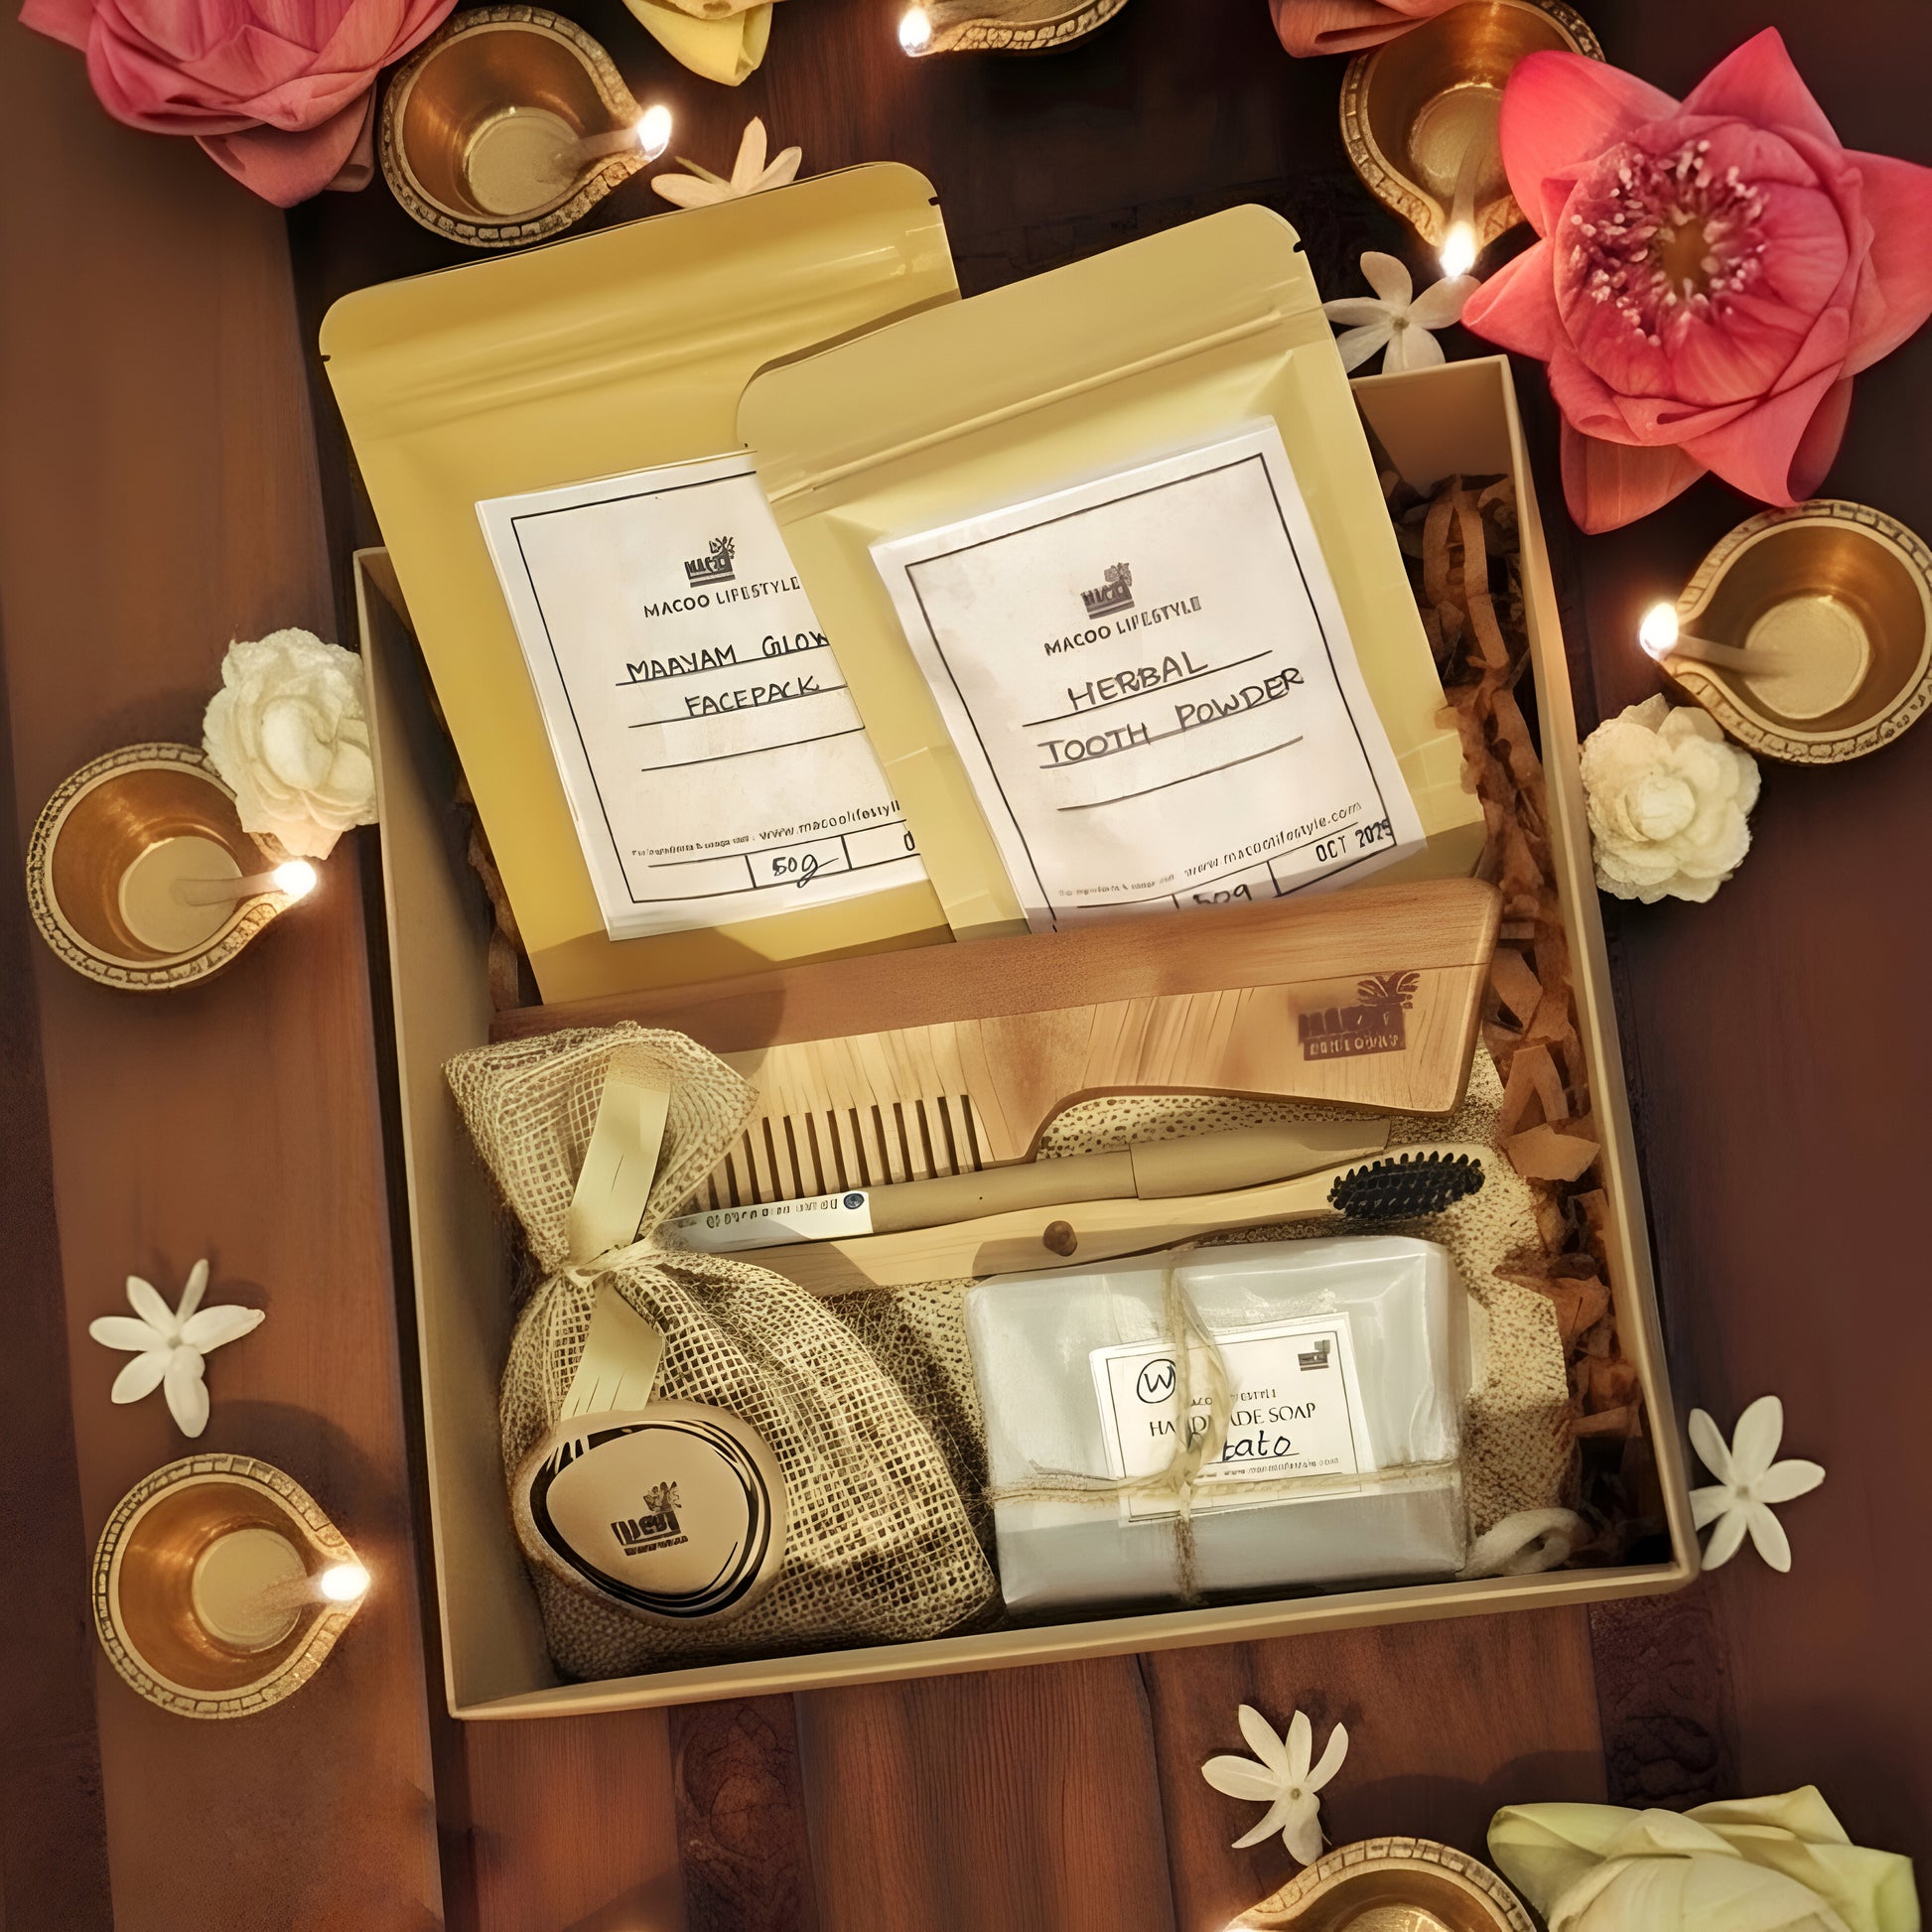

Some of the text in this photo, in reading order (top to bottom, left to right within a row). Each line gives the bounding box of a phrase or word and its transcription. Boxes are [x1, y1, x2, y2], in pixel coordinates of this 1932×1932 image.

[643, 594, 710, 618] MACOO
[1043, 625, 1112, 656] MACOO
[625, 643, 737, 683] MAAYAM
[1067, 650, 1209, 711] HERBAL
[684, 675, 821, 717] FACEPACK
[1036, 667, 1305, 763] TOOTH POWDER
[1314, 835, 1347, 863] OCT
[1268, 1402, 1316, 1423] SOAP
